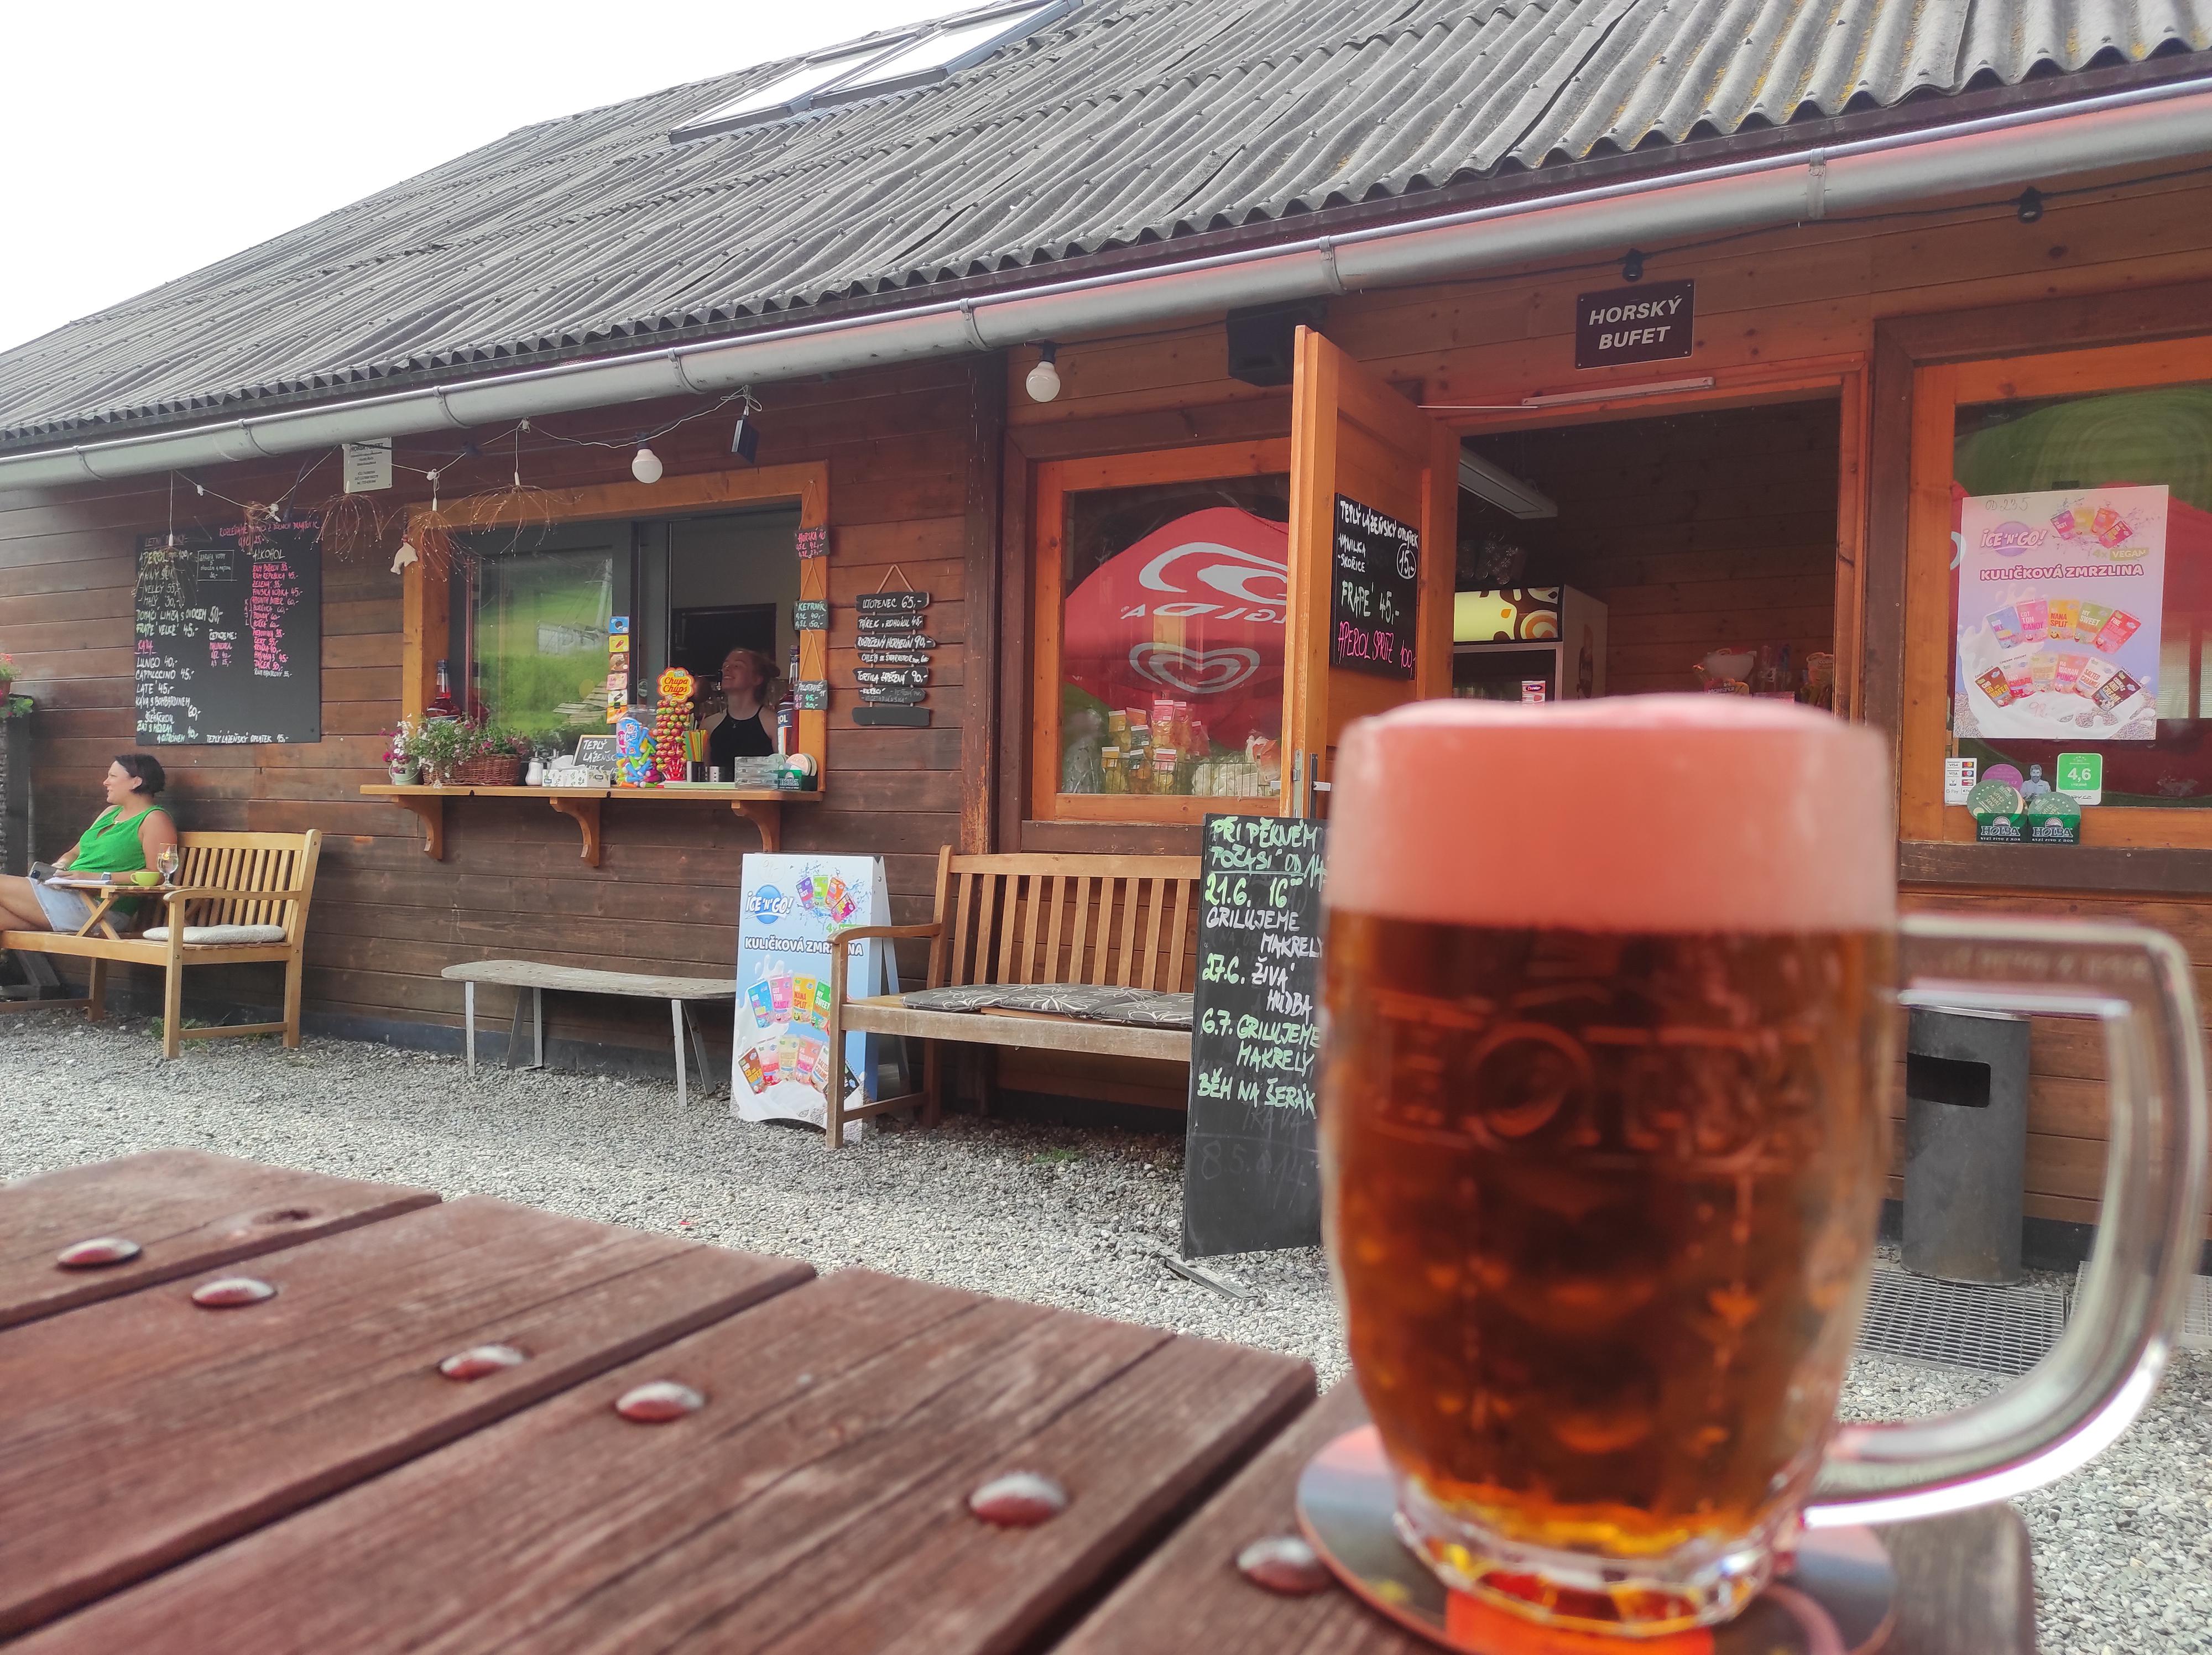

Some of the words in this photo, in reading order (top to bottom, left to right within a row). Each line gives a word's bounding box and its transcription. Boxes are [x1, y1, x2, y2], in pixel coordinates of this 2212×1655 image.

[1588, 295, 1682, 325] HORSKÝ
[1598, 326, 1671, 349] BUFET
[1340, 503, 1361, 526] TEPLÝ
[252, 547, 286, 562] ALKOHOL
[2111, 549, 2145, 558] VEGAN
[1399, 549, 1415, 577] 15,-
[1980, 563, 2063, 581] KULIČKOVÁ
[2065, 563, 2143, 578] ZMRZLINA
[797, 600, 827, 612] KEPRNÍK
[862, 598, 898, 610] UTOPENEC
[901, 595, 922, 609] 65,-
[1340, 579, 1374, 619] FRAPÉ
[1379, 590, 1400, 625] 45,-
[2049, 619, 2068, 628] SPLIT
[2079, 614, 2100, 627] SWEET
[914, 635, 932, 649] 90,-
[1337, 620, 1371, 665] APEROL
[1372, 630, 1394, 664] SPRITZ
[1400, 639, 1416, 679] 100,-
[136, 656, 161, 669] LUNGO
[164, 655, 178, 669] 40,-
[181, 667, 195, 681] 45,-
[664, 677, 689, 686] Chupa
[911, 670, 928, 683] 90,-
[158, 683, 175, 695] 45,-
[663, 685, 687, 696] Chups
[583, 739, 608, 750] TEPLÝ
[2067, 768, 2091, 783] 4,6
[1210, 816, 1242, 843] PŘI
[1245, 816, 1319, 852] PĚKNÉM
[1980, 826, 2021, 837] HOLBA
[2032, 827, 2074, 838] HOLBA
[1209, 844, 1282, 876] POČASÍ
[1284, 853, 1305, 874] OD
[1205, 873, 1252, 909] 21.6.
[1206, 906, 1302, 933] GRILUJEME
[744, 934, 810, 953] KULIČKOVÁ
[1202, 952, 1246, 985] 27.6.
[1250, 956, 1297, 995] ŽIVÁ
[1265, 989, 1313, 1025] HUDBA
[1202, 1007, 1235, 1038] 6.7.
[1237, 1014, 1322, 1053] GRILUJEME
[1197, 1067, 1234, 1101] BĚH
[1238, 1079, 1260, 1109] NA
[1264, 1077, 1318, 1120] ŠERÁK
